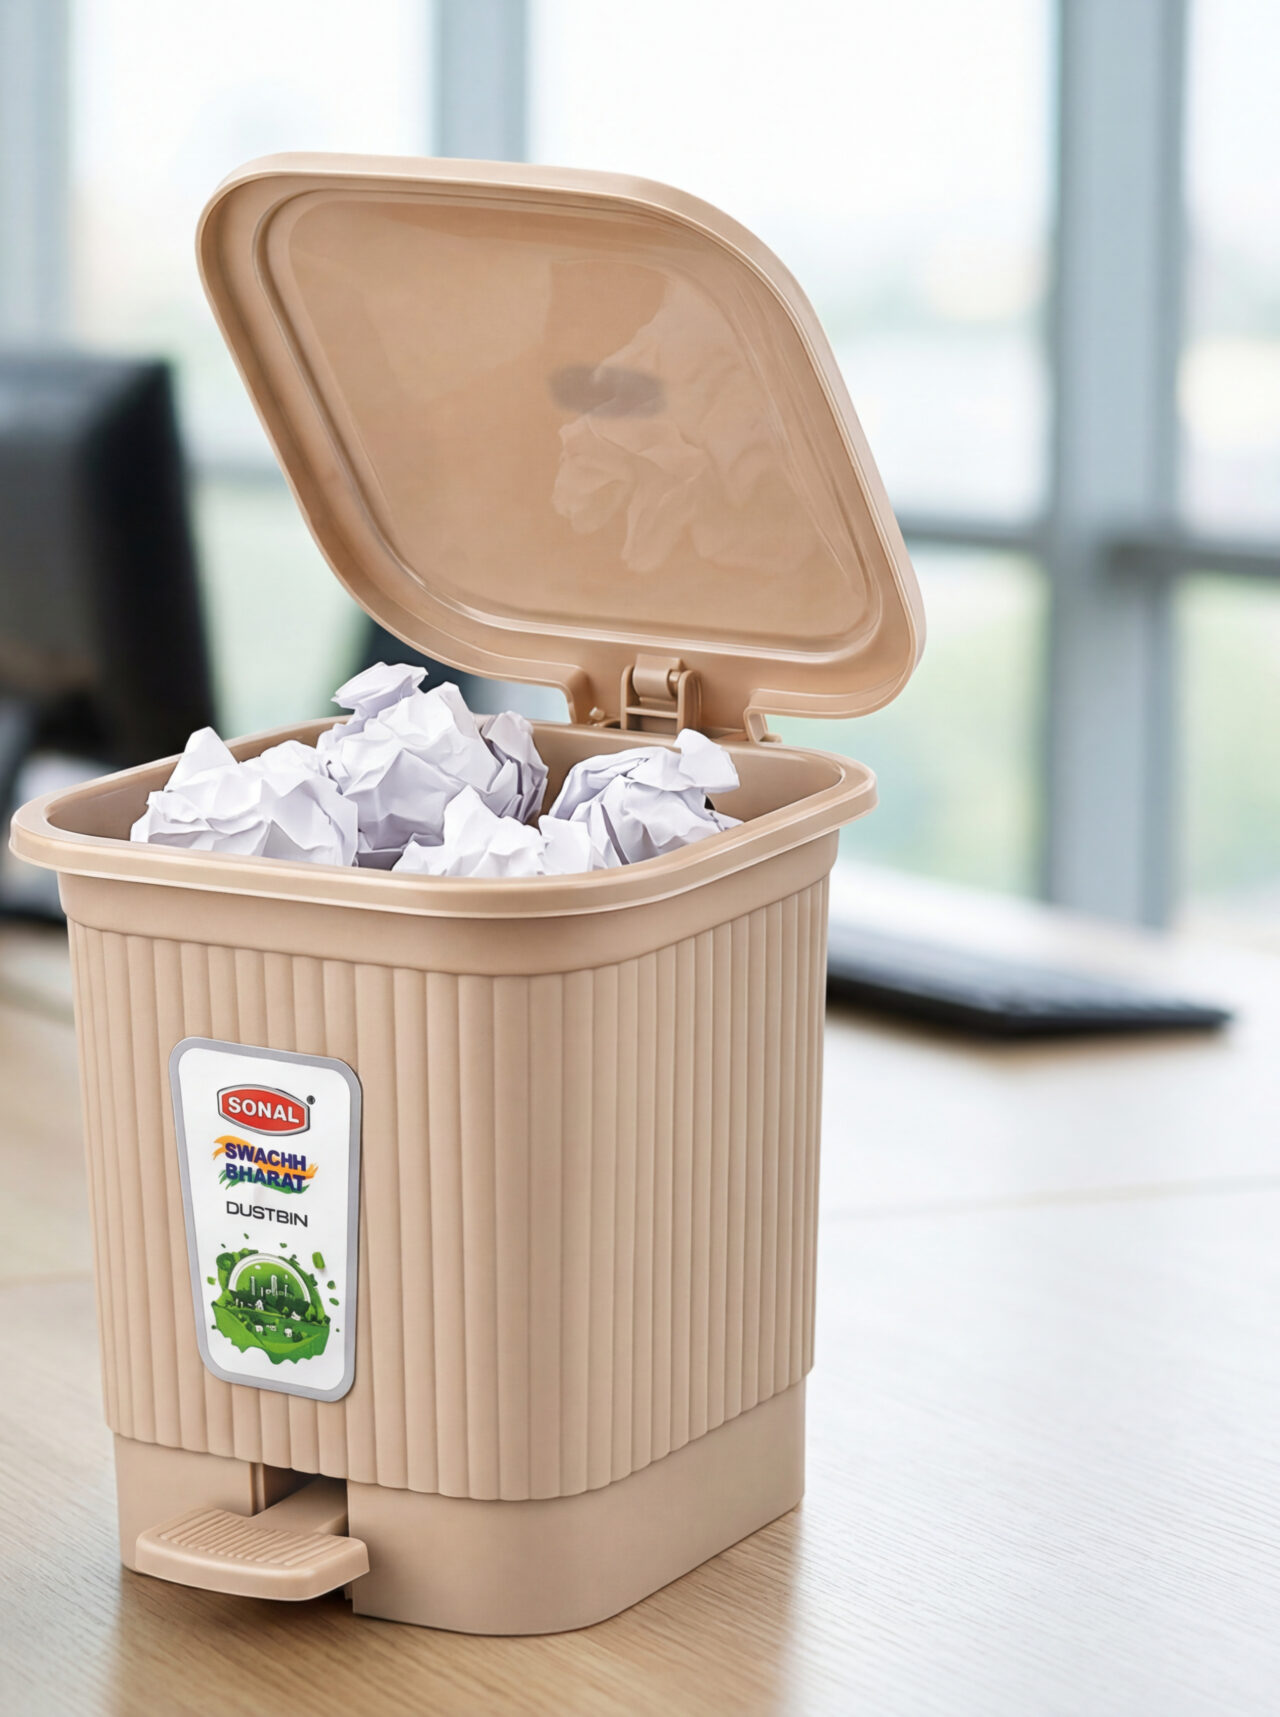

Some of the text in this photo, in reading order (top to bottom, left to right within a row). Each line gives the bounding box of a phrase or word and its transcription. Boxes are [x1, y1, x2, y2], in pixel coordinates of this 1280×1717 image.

[228, 1097, 299, 1123] SONAL
[225, 1142, 306, 1171] SWACHH
[225, 1163, 306, 1192] BHARAT
[226, 1201, 308, 1227] DUSTBIN
